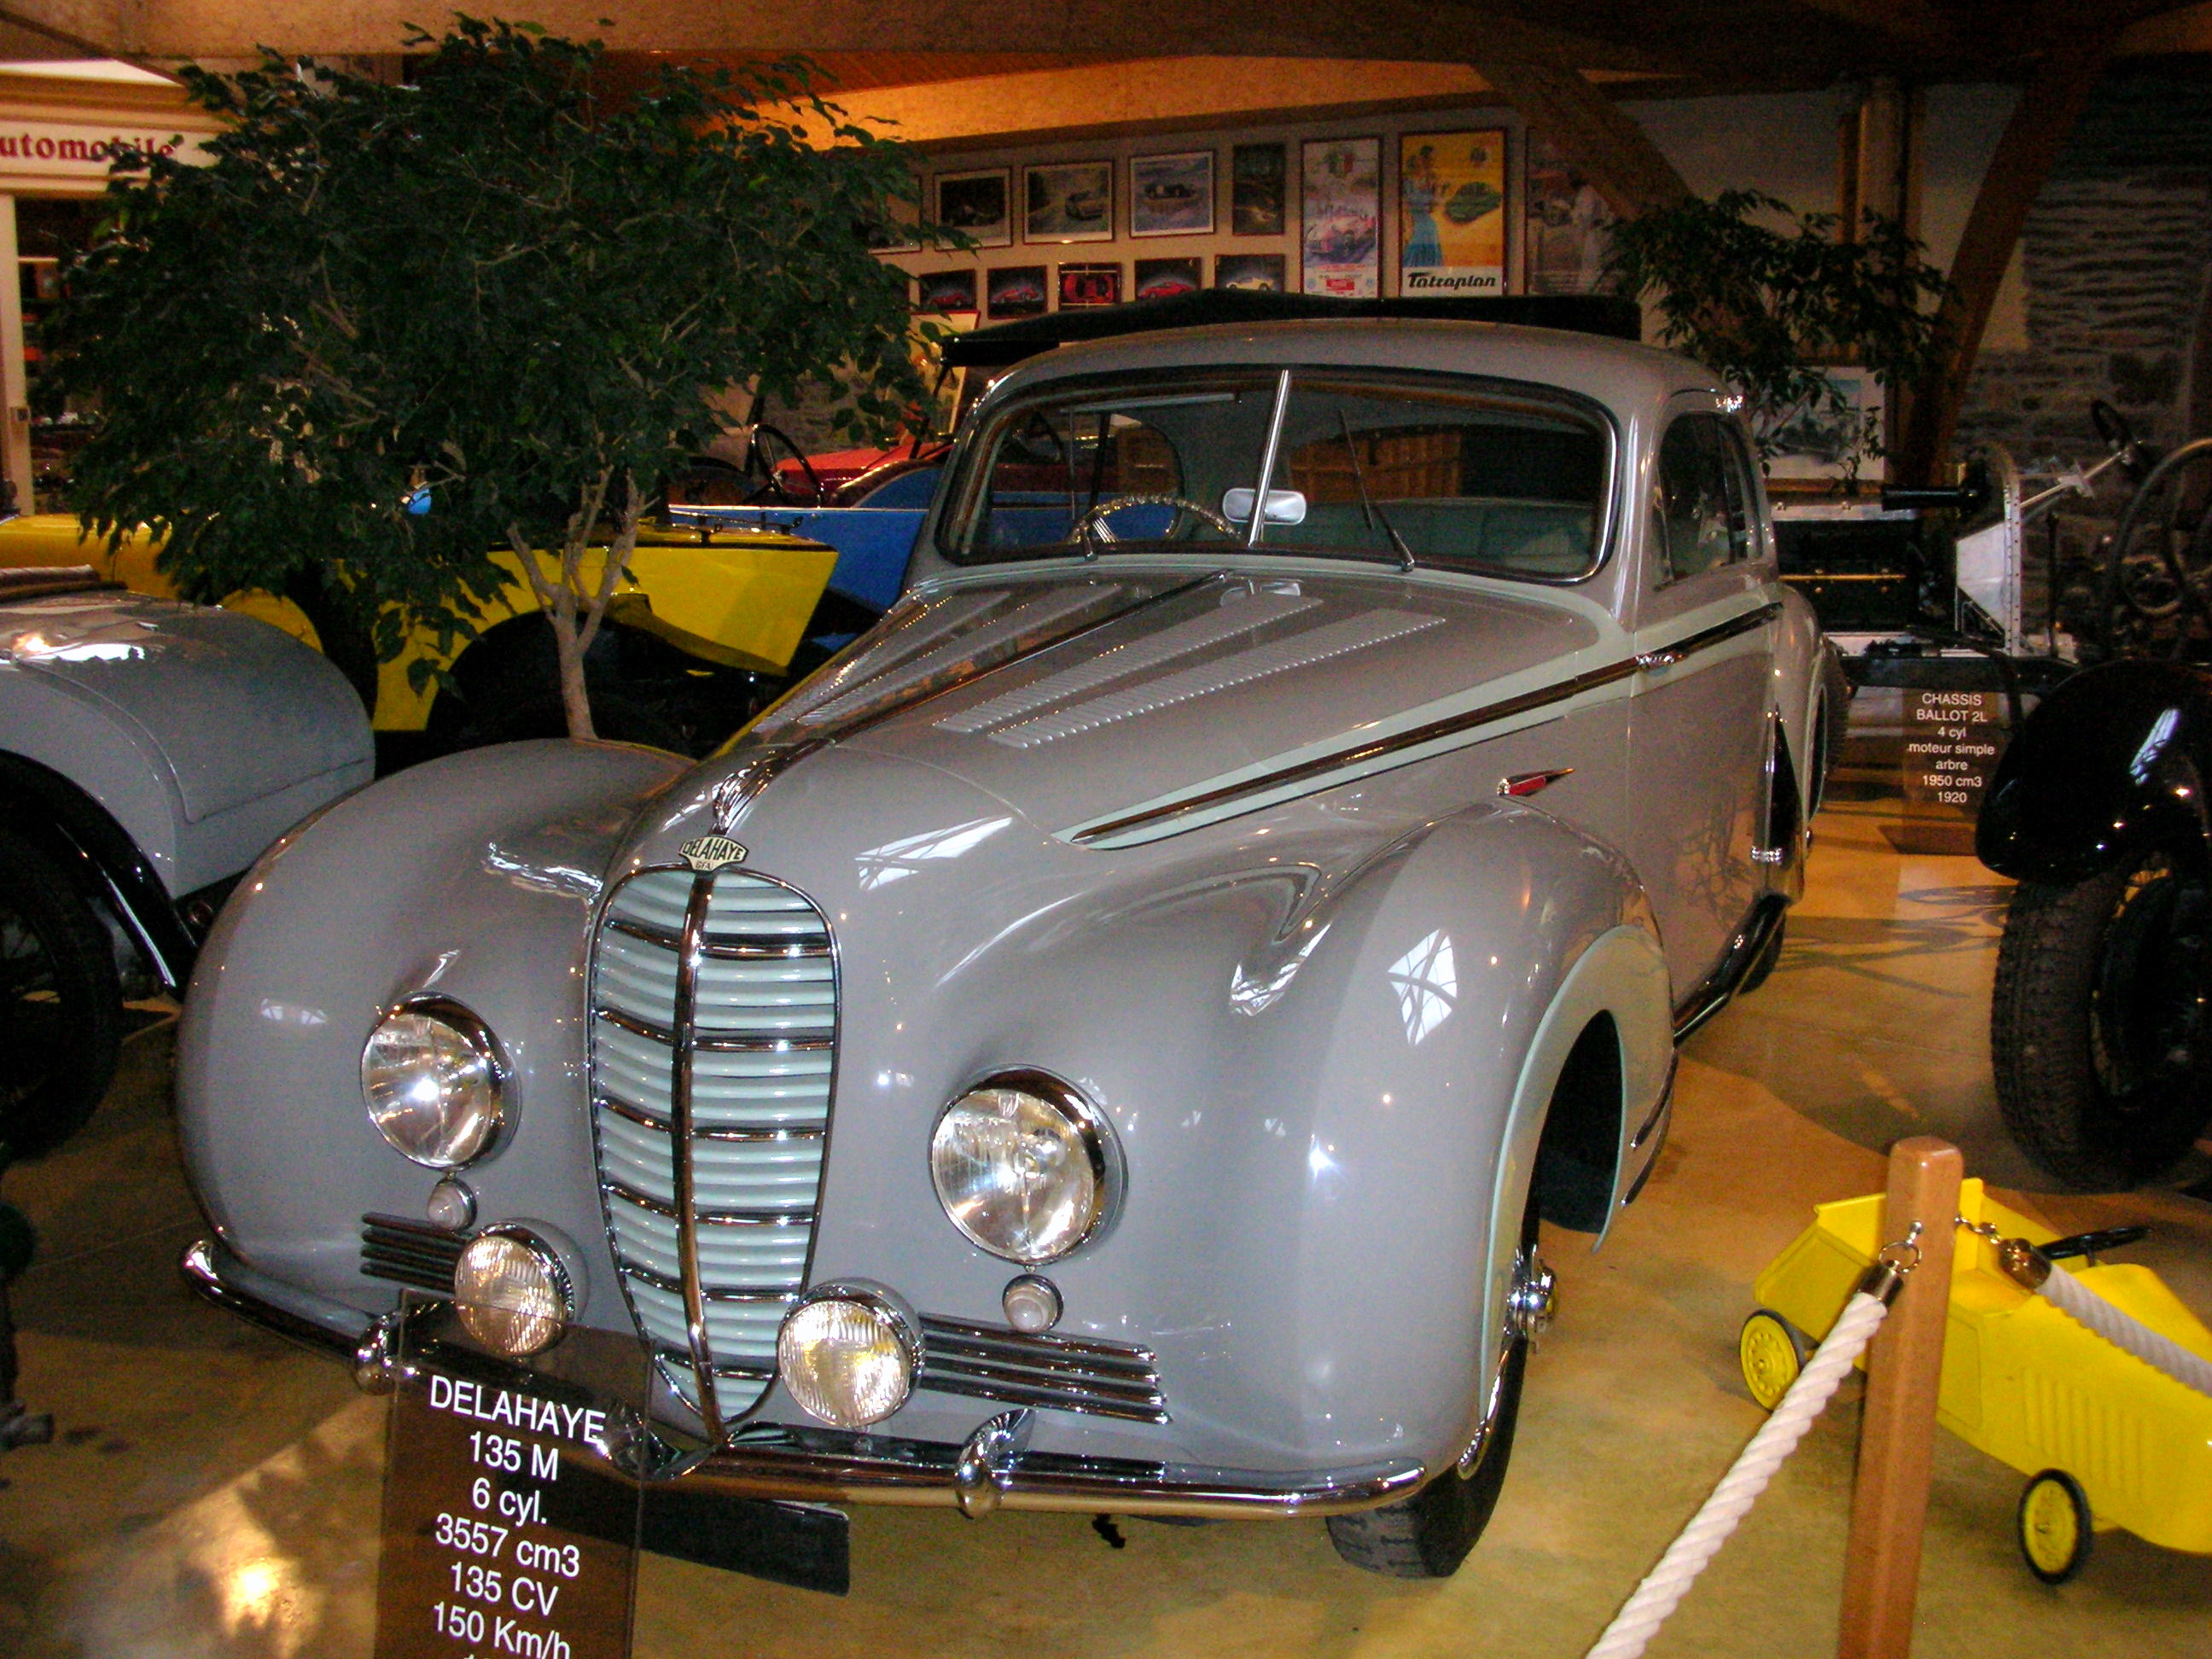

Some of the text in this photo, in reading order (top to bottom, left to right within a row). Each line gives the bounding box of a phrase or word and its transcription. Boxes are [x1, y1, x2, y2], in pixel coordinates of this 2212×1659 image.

[0, 133, 174, 163] utomoile
[1407, 271, 1497, 291] Tatraplan
[1921, 692, 1982, 707] CHASSIS
[1916, 708, 1988, 722] BALLOT 2L
[1937, 725, 1967, 741] 4 cyl
[1908, 742, 1995, 756] moteur simple
[1935, 759, 1969, 771] arbre
[1923, 774, 1982, 787] 1950 cm3
[1937, 791, 1968, 803] 1920
[683, 838, 743, 860] DELAHAYE
[429, 1374, 607, 1446] DELAHAYE
[469, 1430, 559, 1481] 135 M
[472, 1476, 548, 1528] 6 cyl.
[434, 1512, 580, 1578] 3557 cm3
[451, 1561, 560, 1617] 135 CV
[433, 1600, 571, 1659] 150 Km/h
